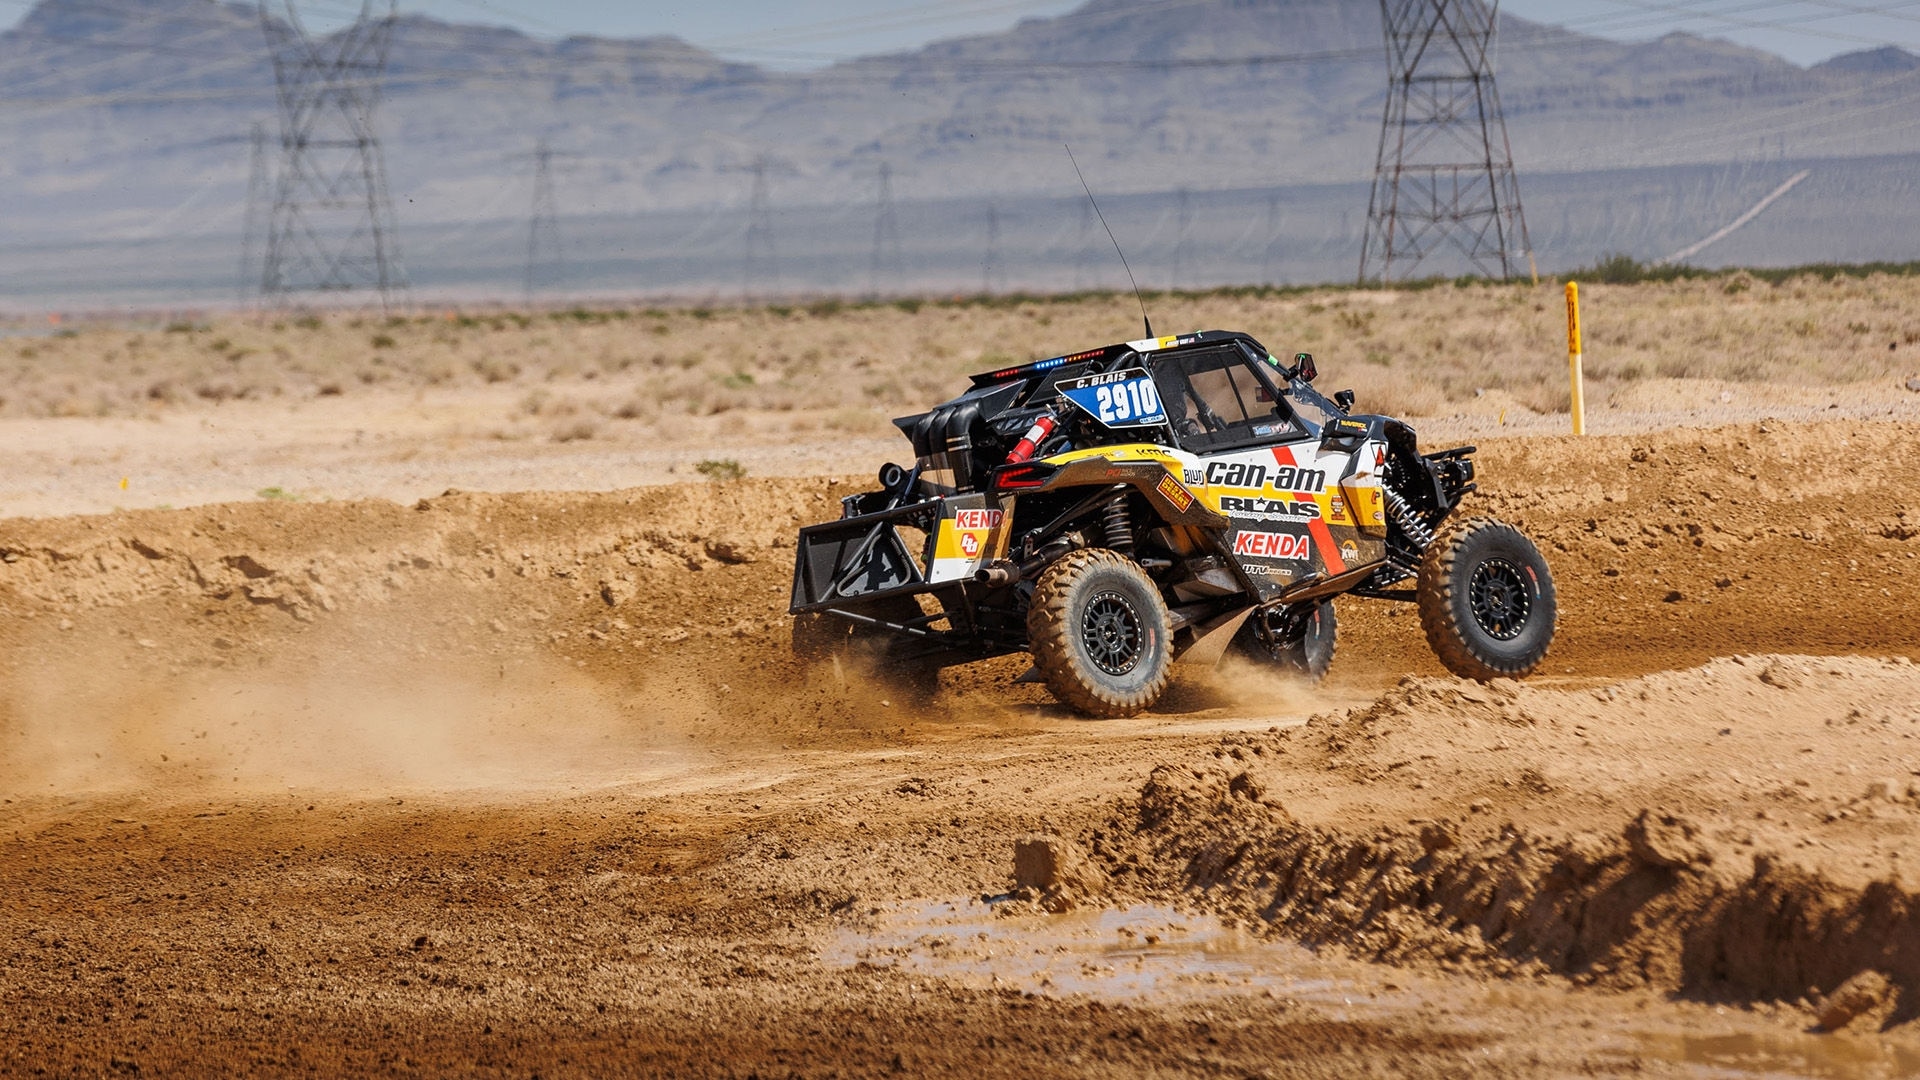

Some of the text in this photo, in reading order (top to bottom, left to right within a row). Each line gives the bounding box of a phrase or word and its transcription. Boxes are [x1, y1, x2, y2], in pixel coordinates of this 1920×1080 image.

[1076, 371, 1127, 389] C. BLAIS
[1096, 378, 1158, 422] 2910
[1205, 461, 1326, 492] can-am
[1220, 496, 1320, 518] BLAIS
[1235, 532, 1308, 558] KENDA
